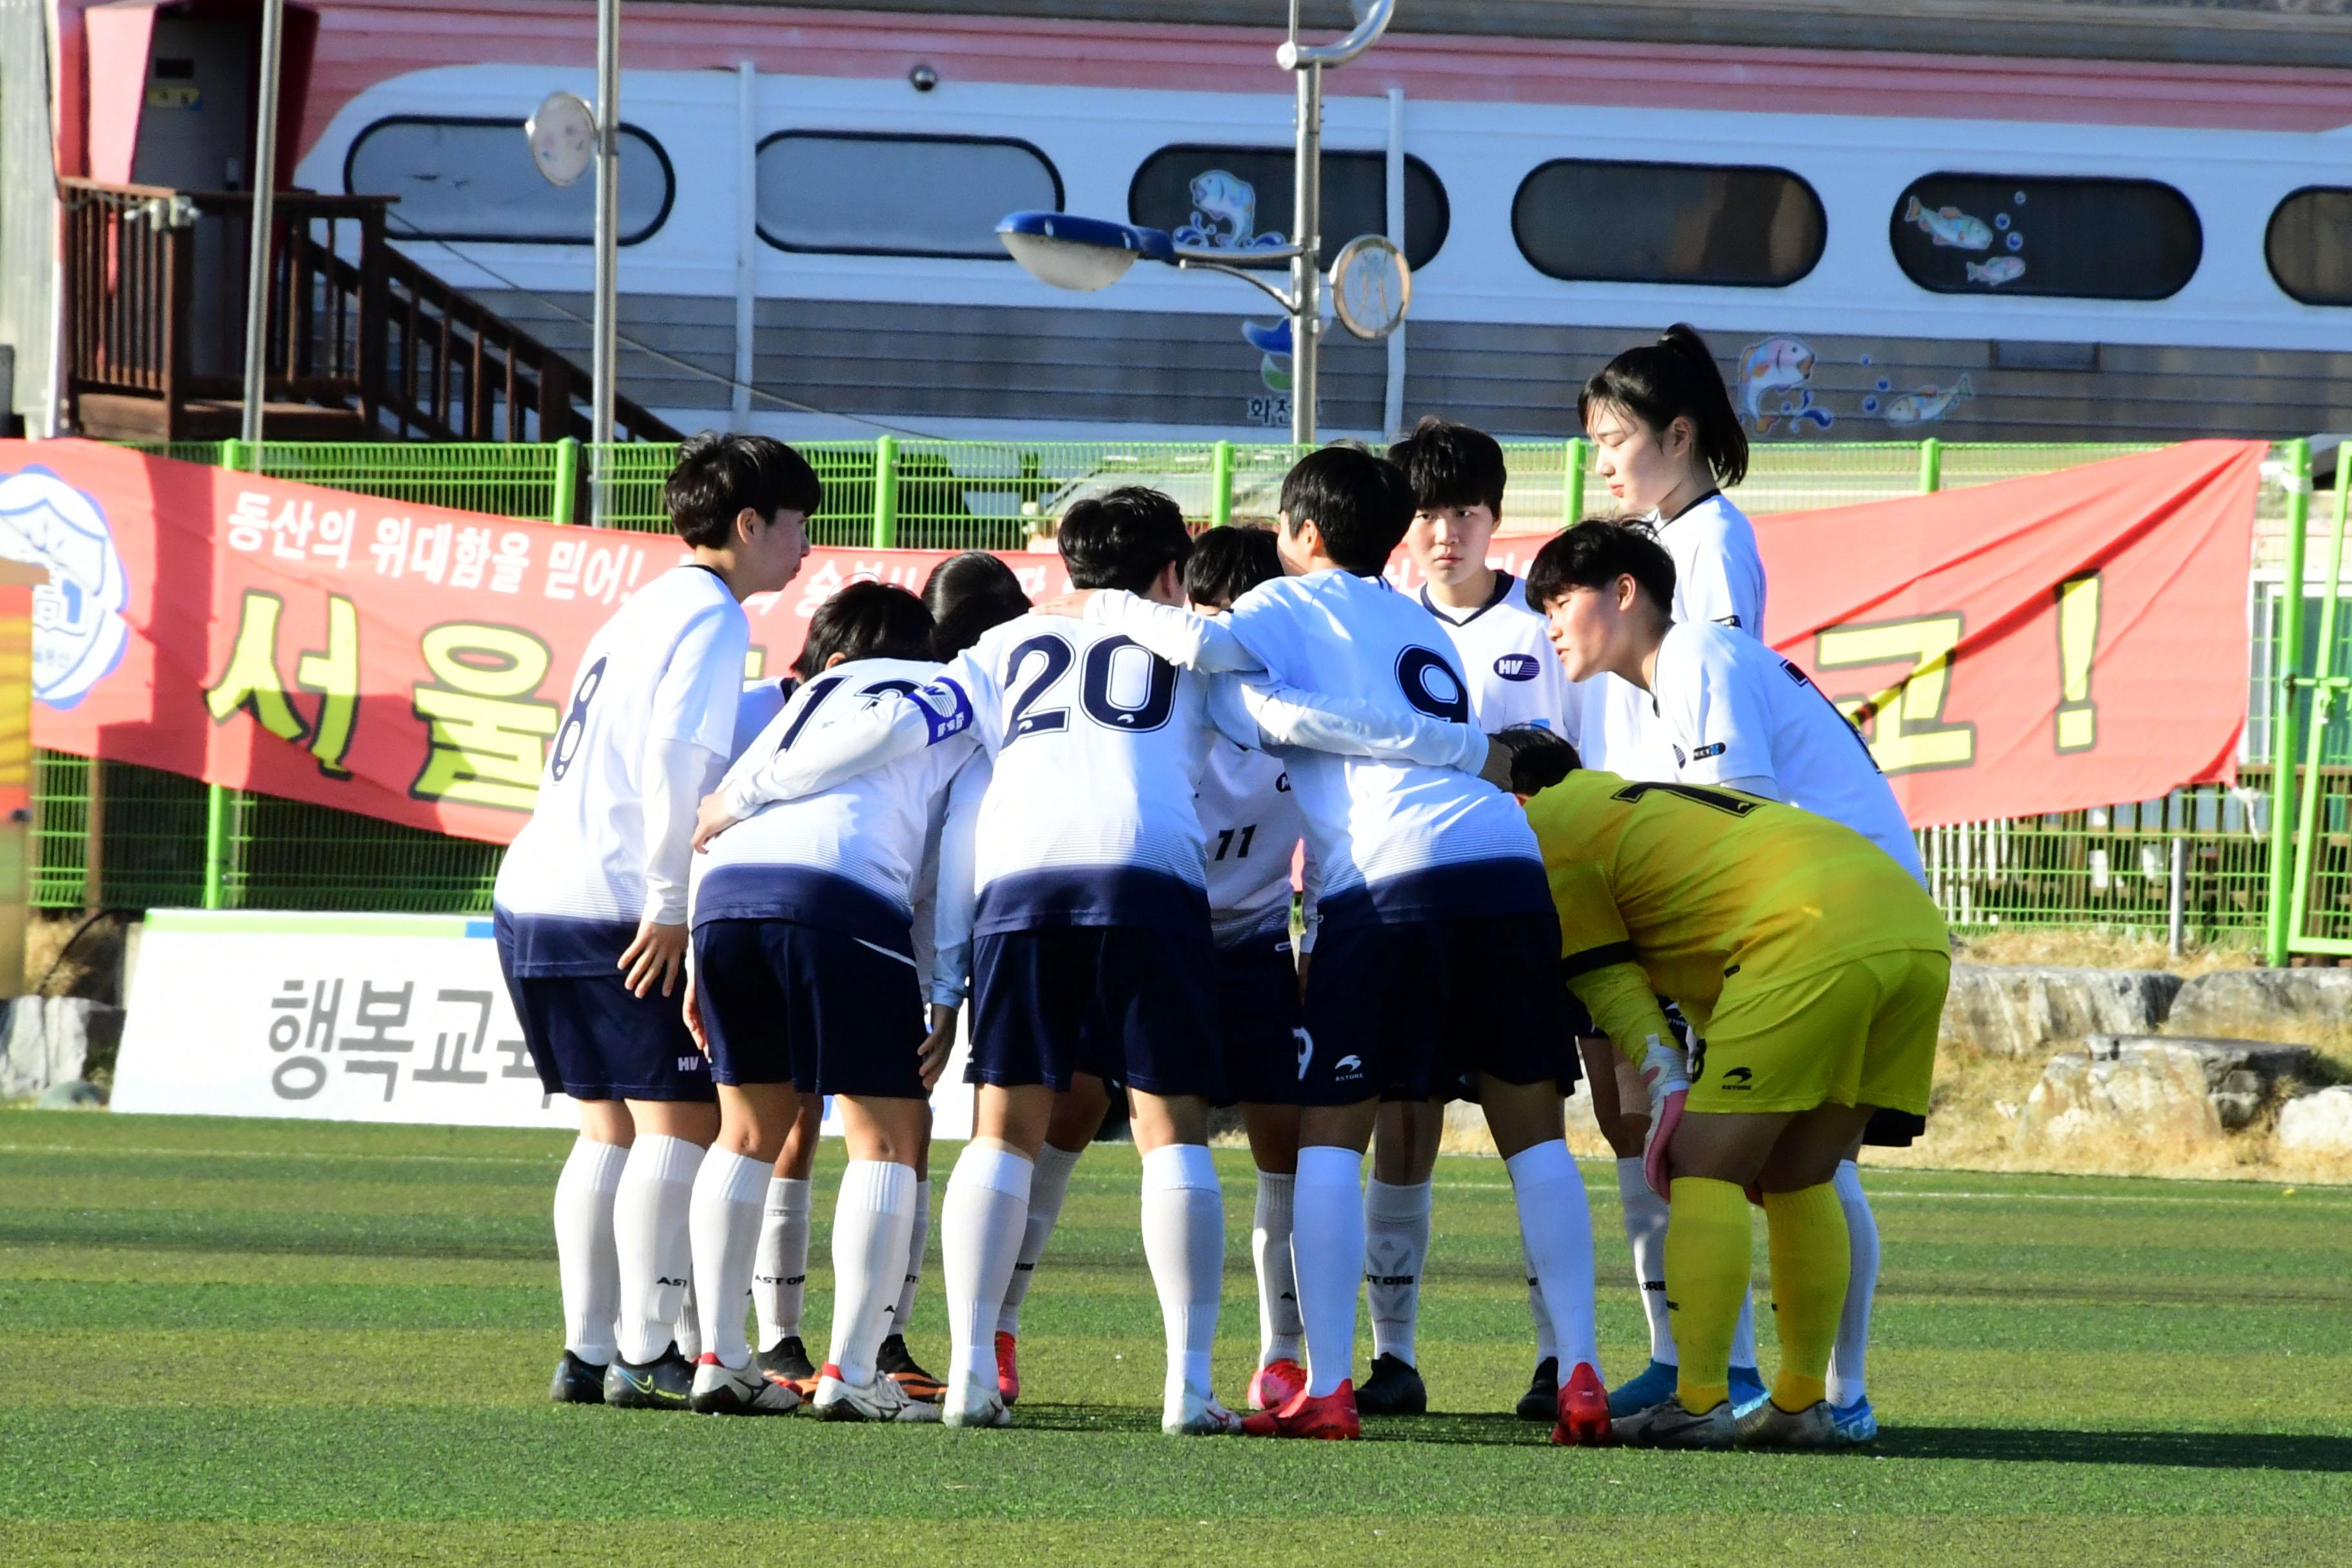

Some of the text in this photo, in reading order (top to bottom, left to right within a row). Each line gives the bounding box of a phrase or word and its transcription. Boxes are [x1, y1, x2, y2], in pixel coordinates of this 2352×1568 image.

[228, 491, 356, 569] 동산의
[369, 516, 531, 594] 위대함을
[544, 540, 644, 605] 믿어!
[203, 588, 561, 815] 서울
[550, 652, 610, 786] 8
[998, 631, 1180, 757] 20
[1498, 660, 1523, 675] HV
[1214, 823, 1257, 861] 11
[677, 1056, 700, 1072] HV
